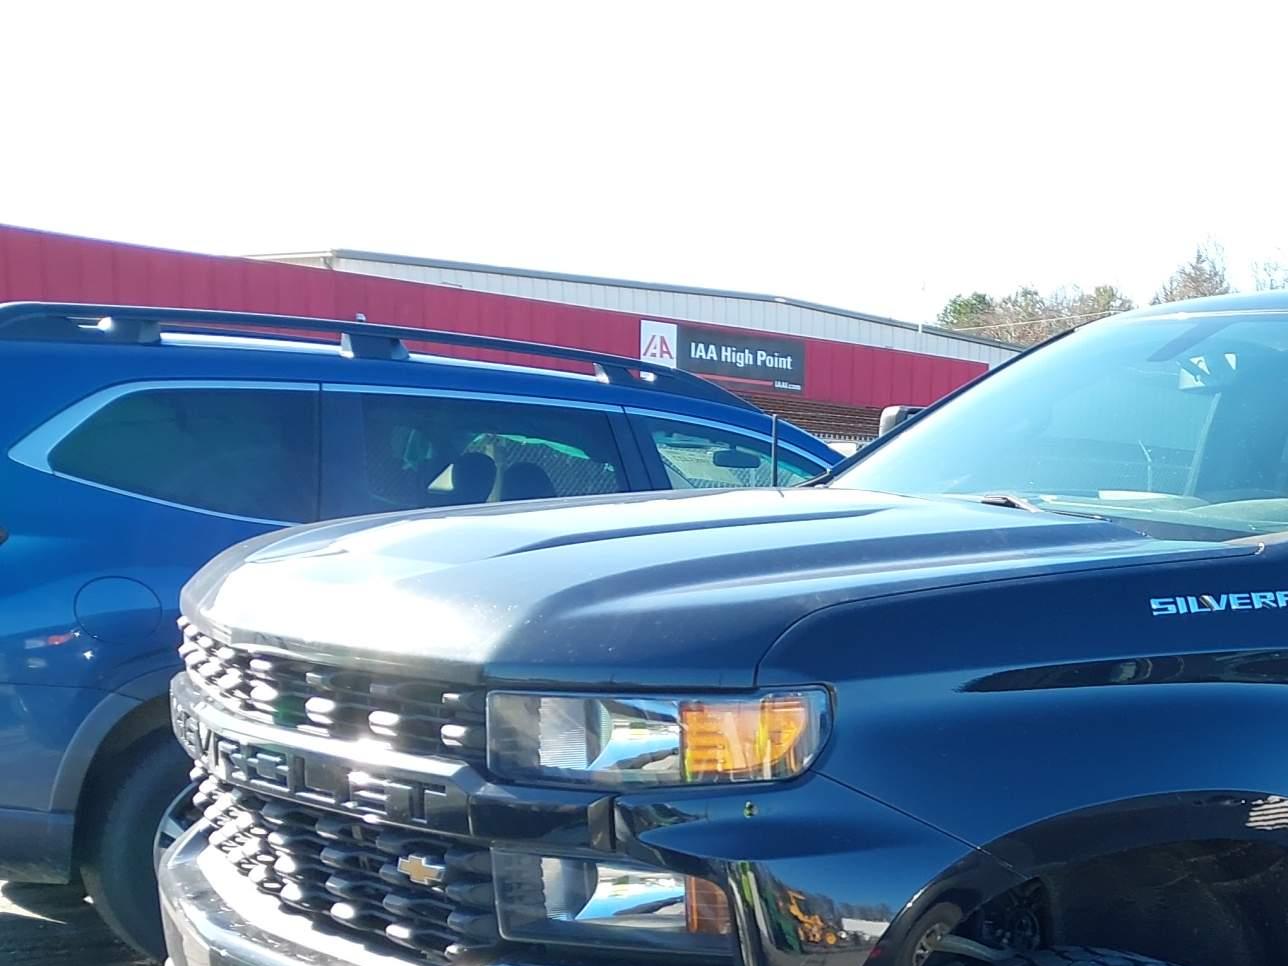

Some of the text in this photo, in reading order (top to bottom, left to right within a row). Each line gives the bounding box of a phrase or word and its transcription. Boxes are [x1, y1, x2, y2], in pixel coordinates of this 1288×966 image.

[690, 342, 793, 370] IAA High Point
[174, 700, 447, 824] HEVROLET
